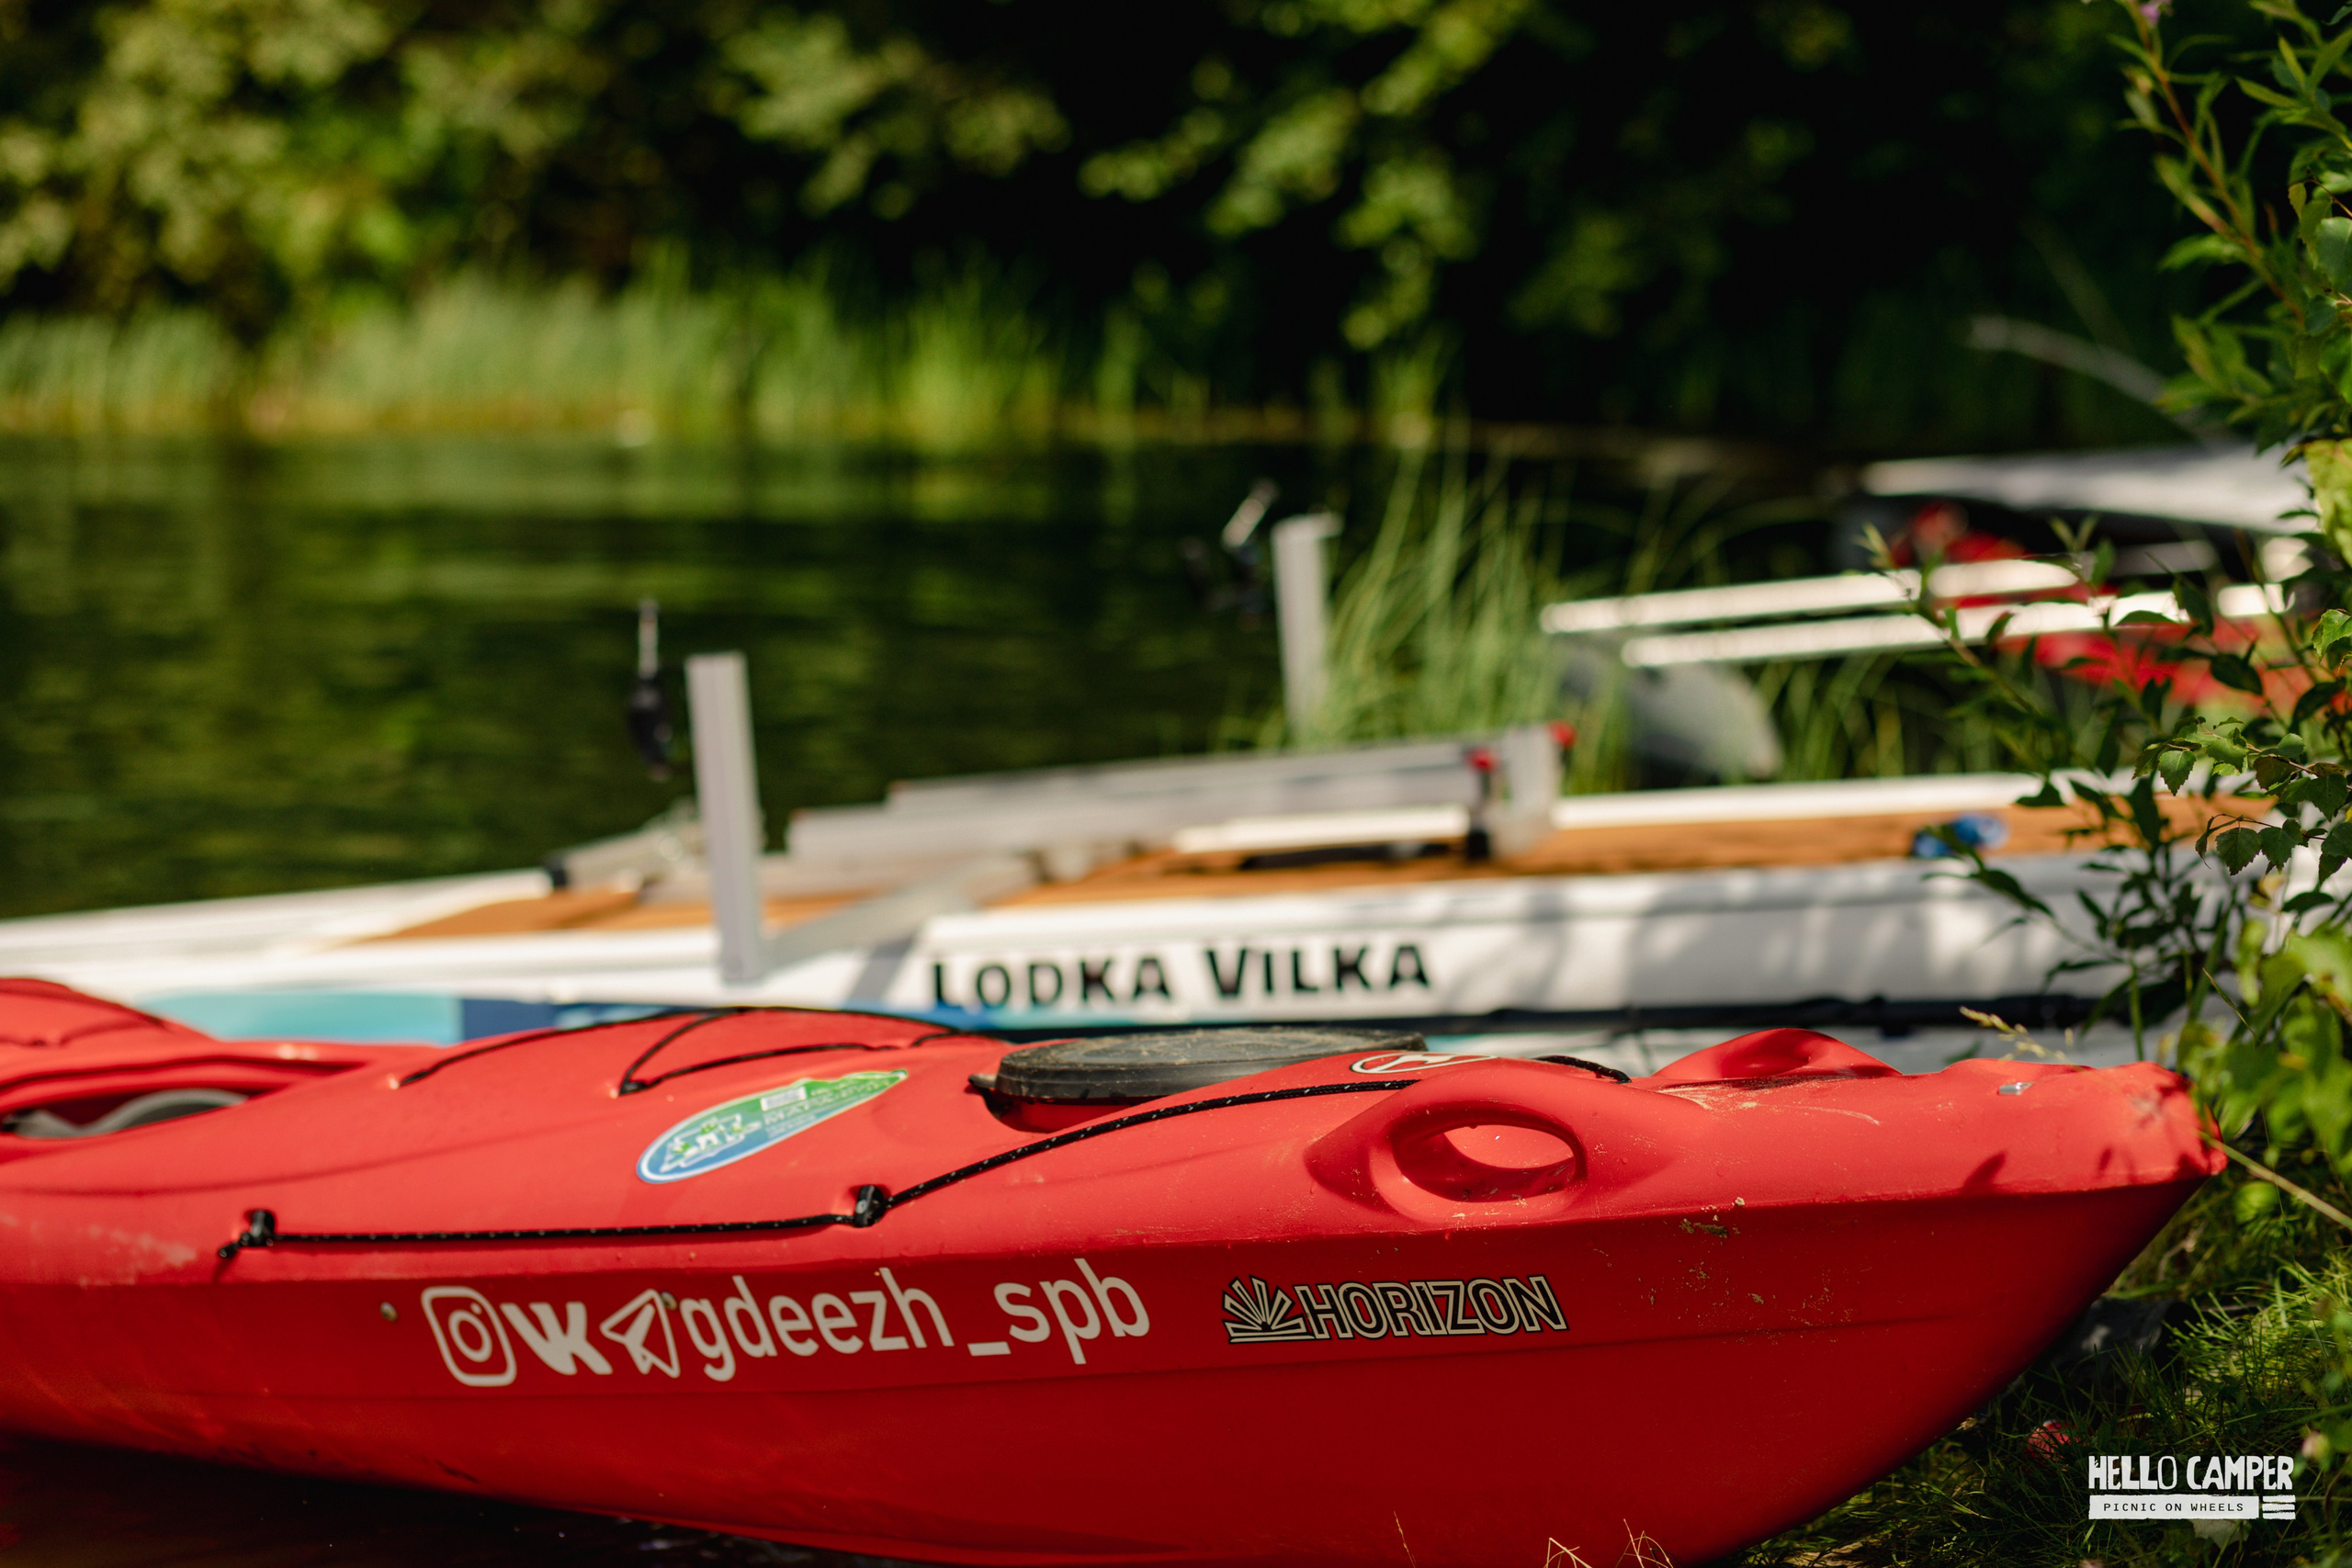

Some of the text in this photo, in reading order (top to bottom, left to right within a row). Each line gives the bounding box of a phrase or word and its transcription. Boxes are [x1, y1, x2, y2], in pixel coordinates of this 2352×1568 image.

[932, 945, 1430, 1008] LODKA VILKA
[681, 1258, 1150, 1382] gdeezh_spb
[1294, 1274, 1570, 1340] HORIZON
